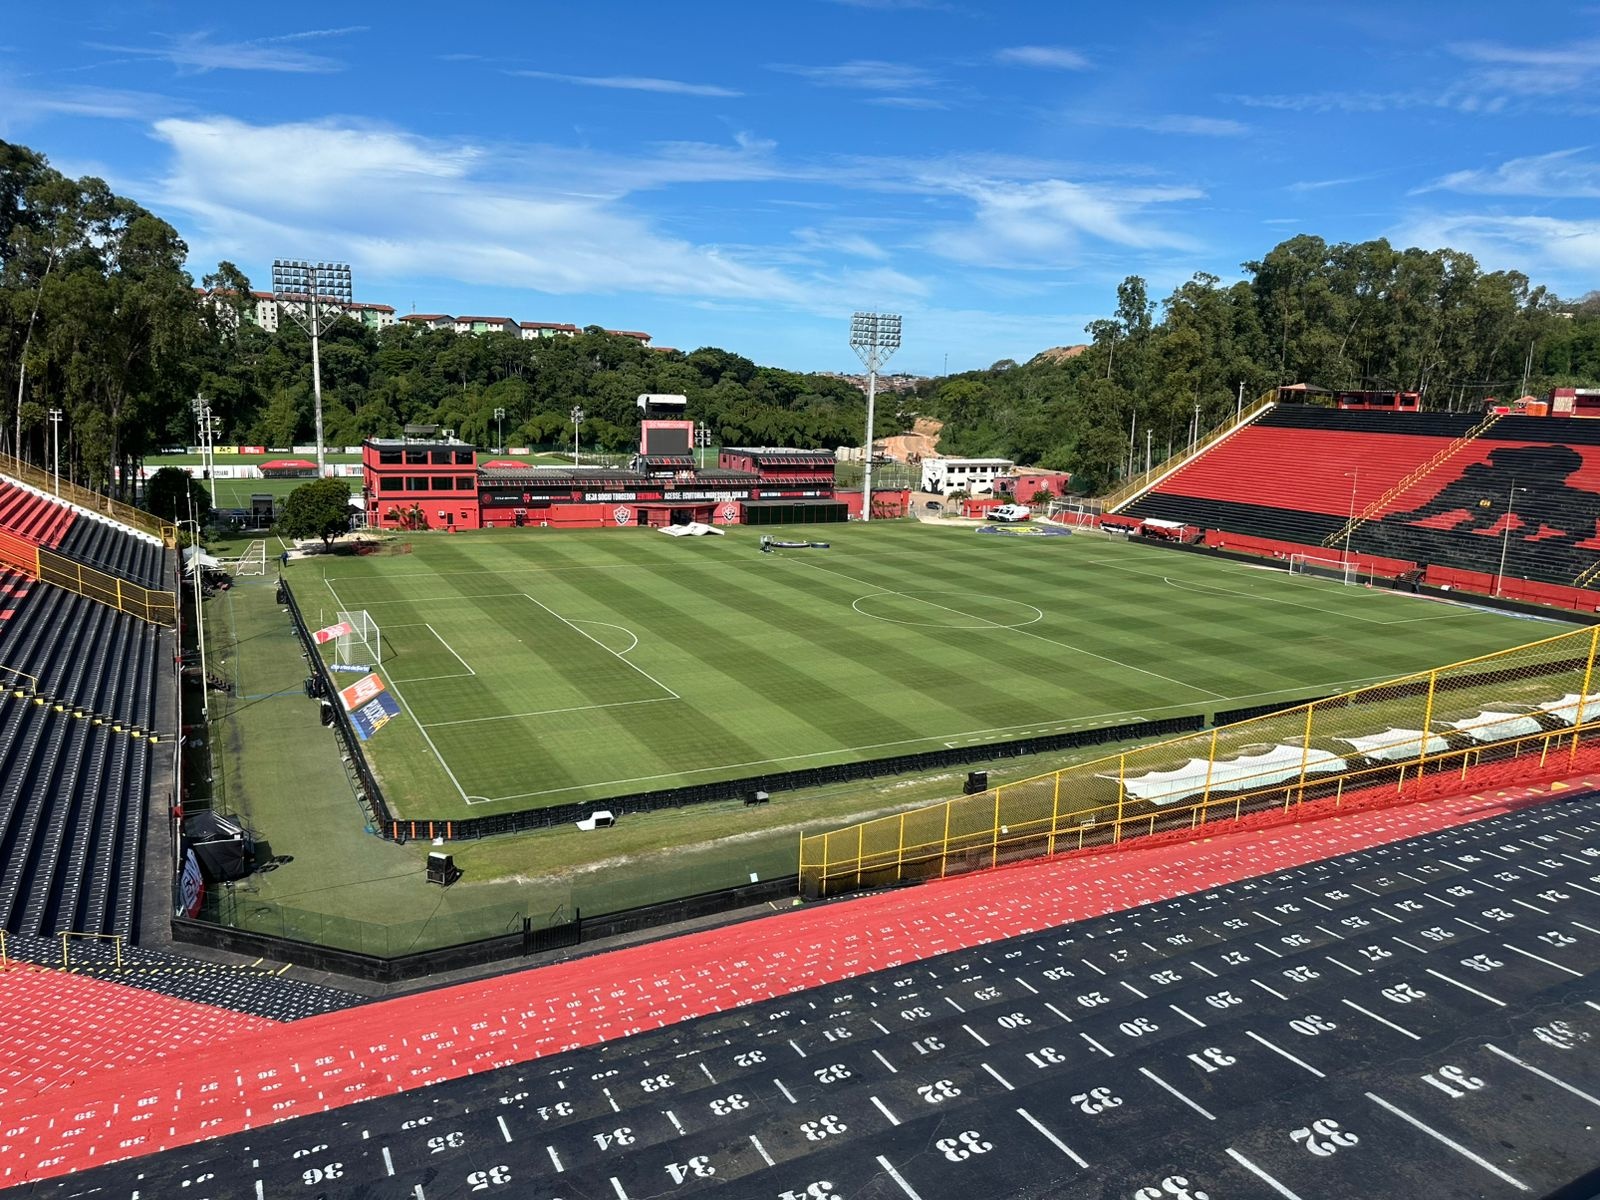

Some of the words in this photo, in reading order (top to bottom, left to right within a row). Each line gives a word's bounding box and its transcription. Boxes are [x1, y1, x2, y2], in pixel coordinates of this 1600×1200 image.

[586, 493, 597, 501] SEJA
[612, 492, 636, 500] TORCEDOR
[1536, 890, 1570, 902] 24
[1341, 916, 1370, 928] 25
[1482, 908, 1514, 921] 25
[1281, 934, 1311, 946] 26
[1421, 927, 1454, 941] 26
[1538, 931, 1577, 947] 27
[1221, 951, 1250, 965] 27
[1359, 945, 1392, 961] 27
[1460, 954, 1504, 971] 28
[1043, 967, 1075, 980] 28
[1150, 970, 1182, 984] 28
[1283, 966, 1320, 982] 28
[974, 987, 1002, 1000] 29
[1077, 992, 1110, 1007] 29
[1206, 991, 1242, 1008] 29
[1382, 983, 1426, 1003] 29
[901, 1007, 931, 1021] 30
[998, 1013, 1031, 1028] 30
[1120, 1018, 1159, 1037] 30
[1289, 1015, 1336, 1035] 30
[823, 1027, 852, 1041] 31
[912, 1037, 945, 1054] 31
[734, 1051, 766, 1066] 32
[1025, 1047, 1065, 1068] 31
[1187, 1048, 1236, 1072] 31
[814, 1064, 851, 1083] 32
[1421, 1065, 1485, 1098] 31
[640, 1074, 675, 1092] 33
[917, 1080, 961, 1103] 32
[710, 1094, 749, 1115] 33
[1071, 1087, 1122, 1114] 32
[800, 1115, 847, 1140] 33
[427, 1132, 465, 1154] 35
[593, 1128, 635, 1150] 34
[936, 1131, 992, 1161] 33
[1290, 1119, 1358, 1156] 32
[303, 1163, 343, 1185] 36
[467, 1166, 511, 1191] 35
[664, 1156, 715, 1184] 34
